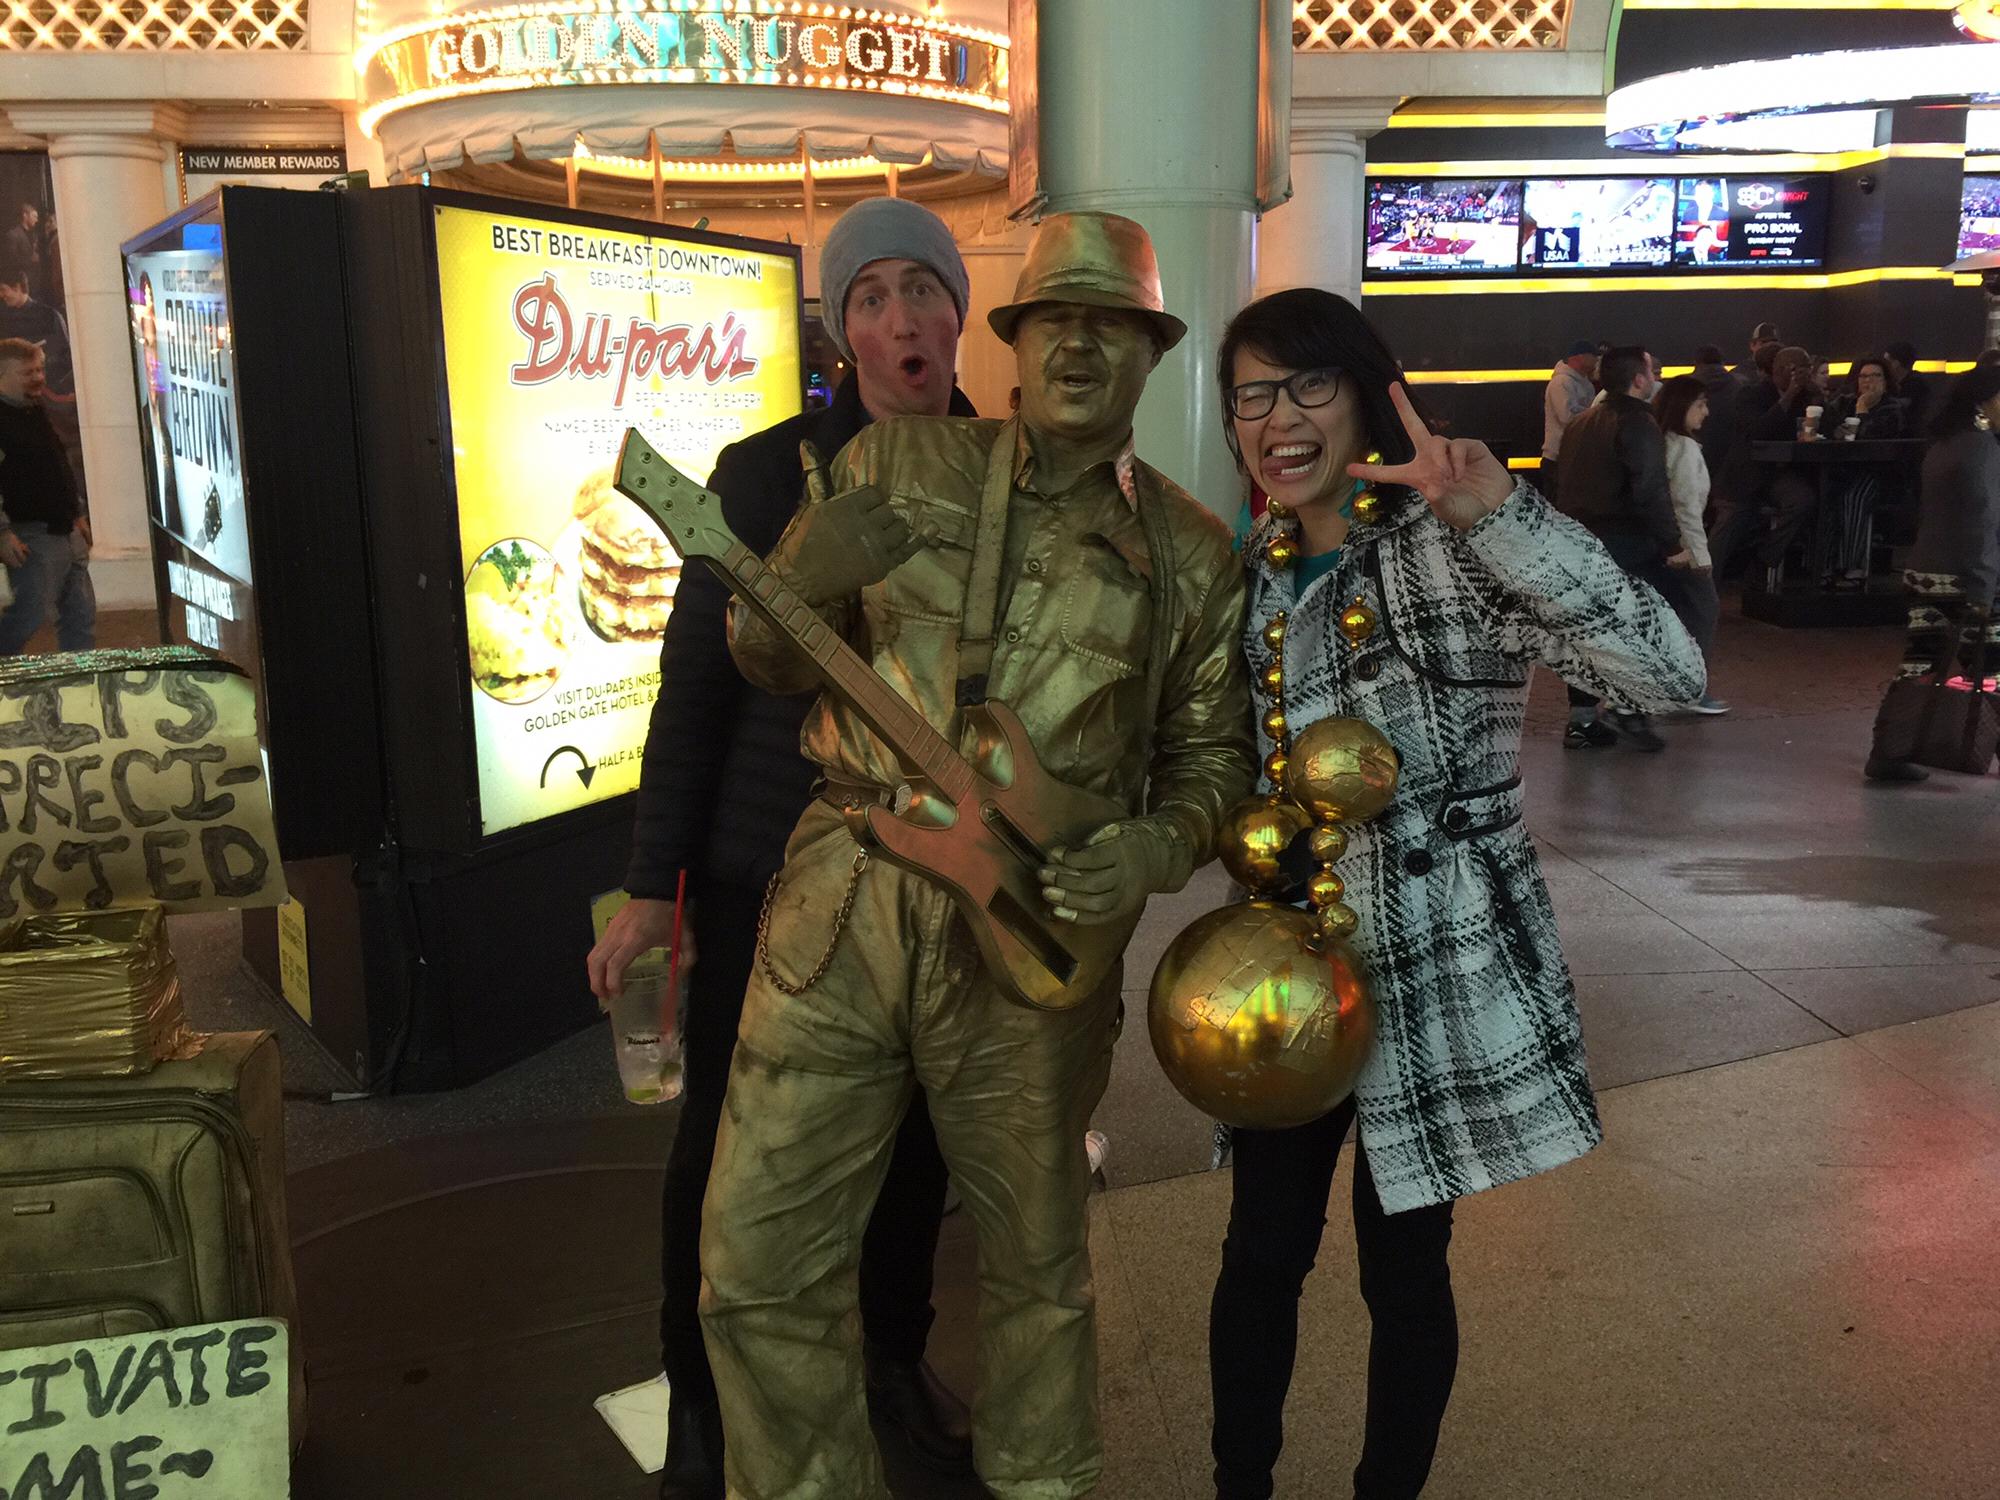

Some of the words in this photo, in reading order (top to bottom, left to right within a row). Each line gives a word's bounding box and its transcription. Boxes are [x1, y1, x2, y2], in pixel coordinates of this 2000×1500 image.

[429, 14, 663, 80] GOLDEN
[700, 15, 951, 82] NUGGET
[189, 155, 220, 169] NEW
[223, 155, 277, 169] MEMBER
[279, 155, 341, 170] REWARDS
[1744, 223, 1769, 234] PRO
[1770, 223, 1803, 234] BOWL
[492, 225, 542, 254] BEST
[549, 233, 653, 267] BREAKFAST
[659, 249, 761, 280] DOWNTOWN!
[1543, 250, 1570, 262] USAA
[590, 271, 634, 289] SERVED
[638, 277, 651, 291] 24
[170, 382, 235, 477] BROWN
[554, 689, 582, 705] VISIT
[586, 679, 633, 700] DU-PAR'S
[636, 671, 662, 688] INSID
[0, 670, 227, 753] IPS
[524, 710, 577, 733] GOLDEN
[579, 701, 608, 719] GATE
[611, 693, 645, 710] HOTEL
[599, 751, 625, 769] HALF
[0, 743, 261, 834] PRECI-
[0, 1325, 277, 1435] IVATE
